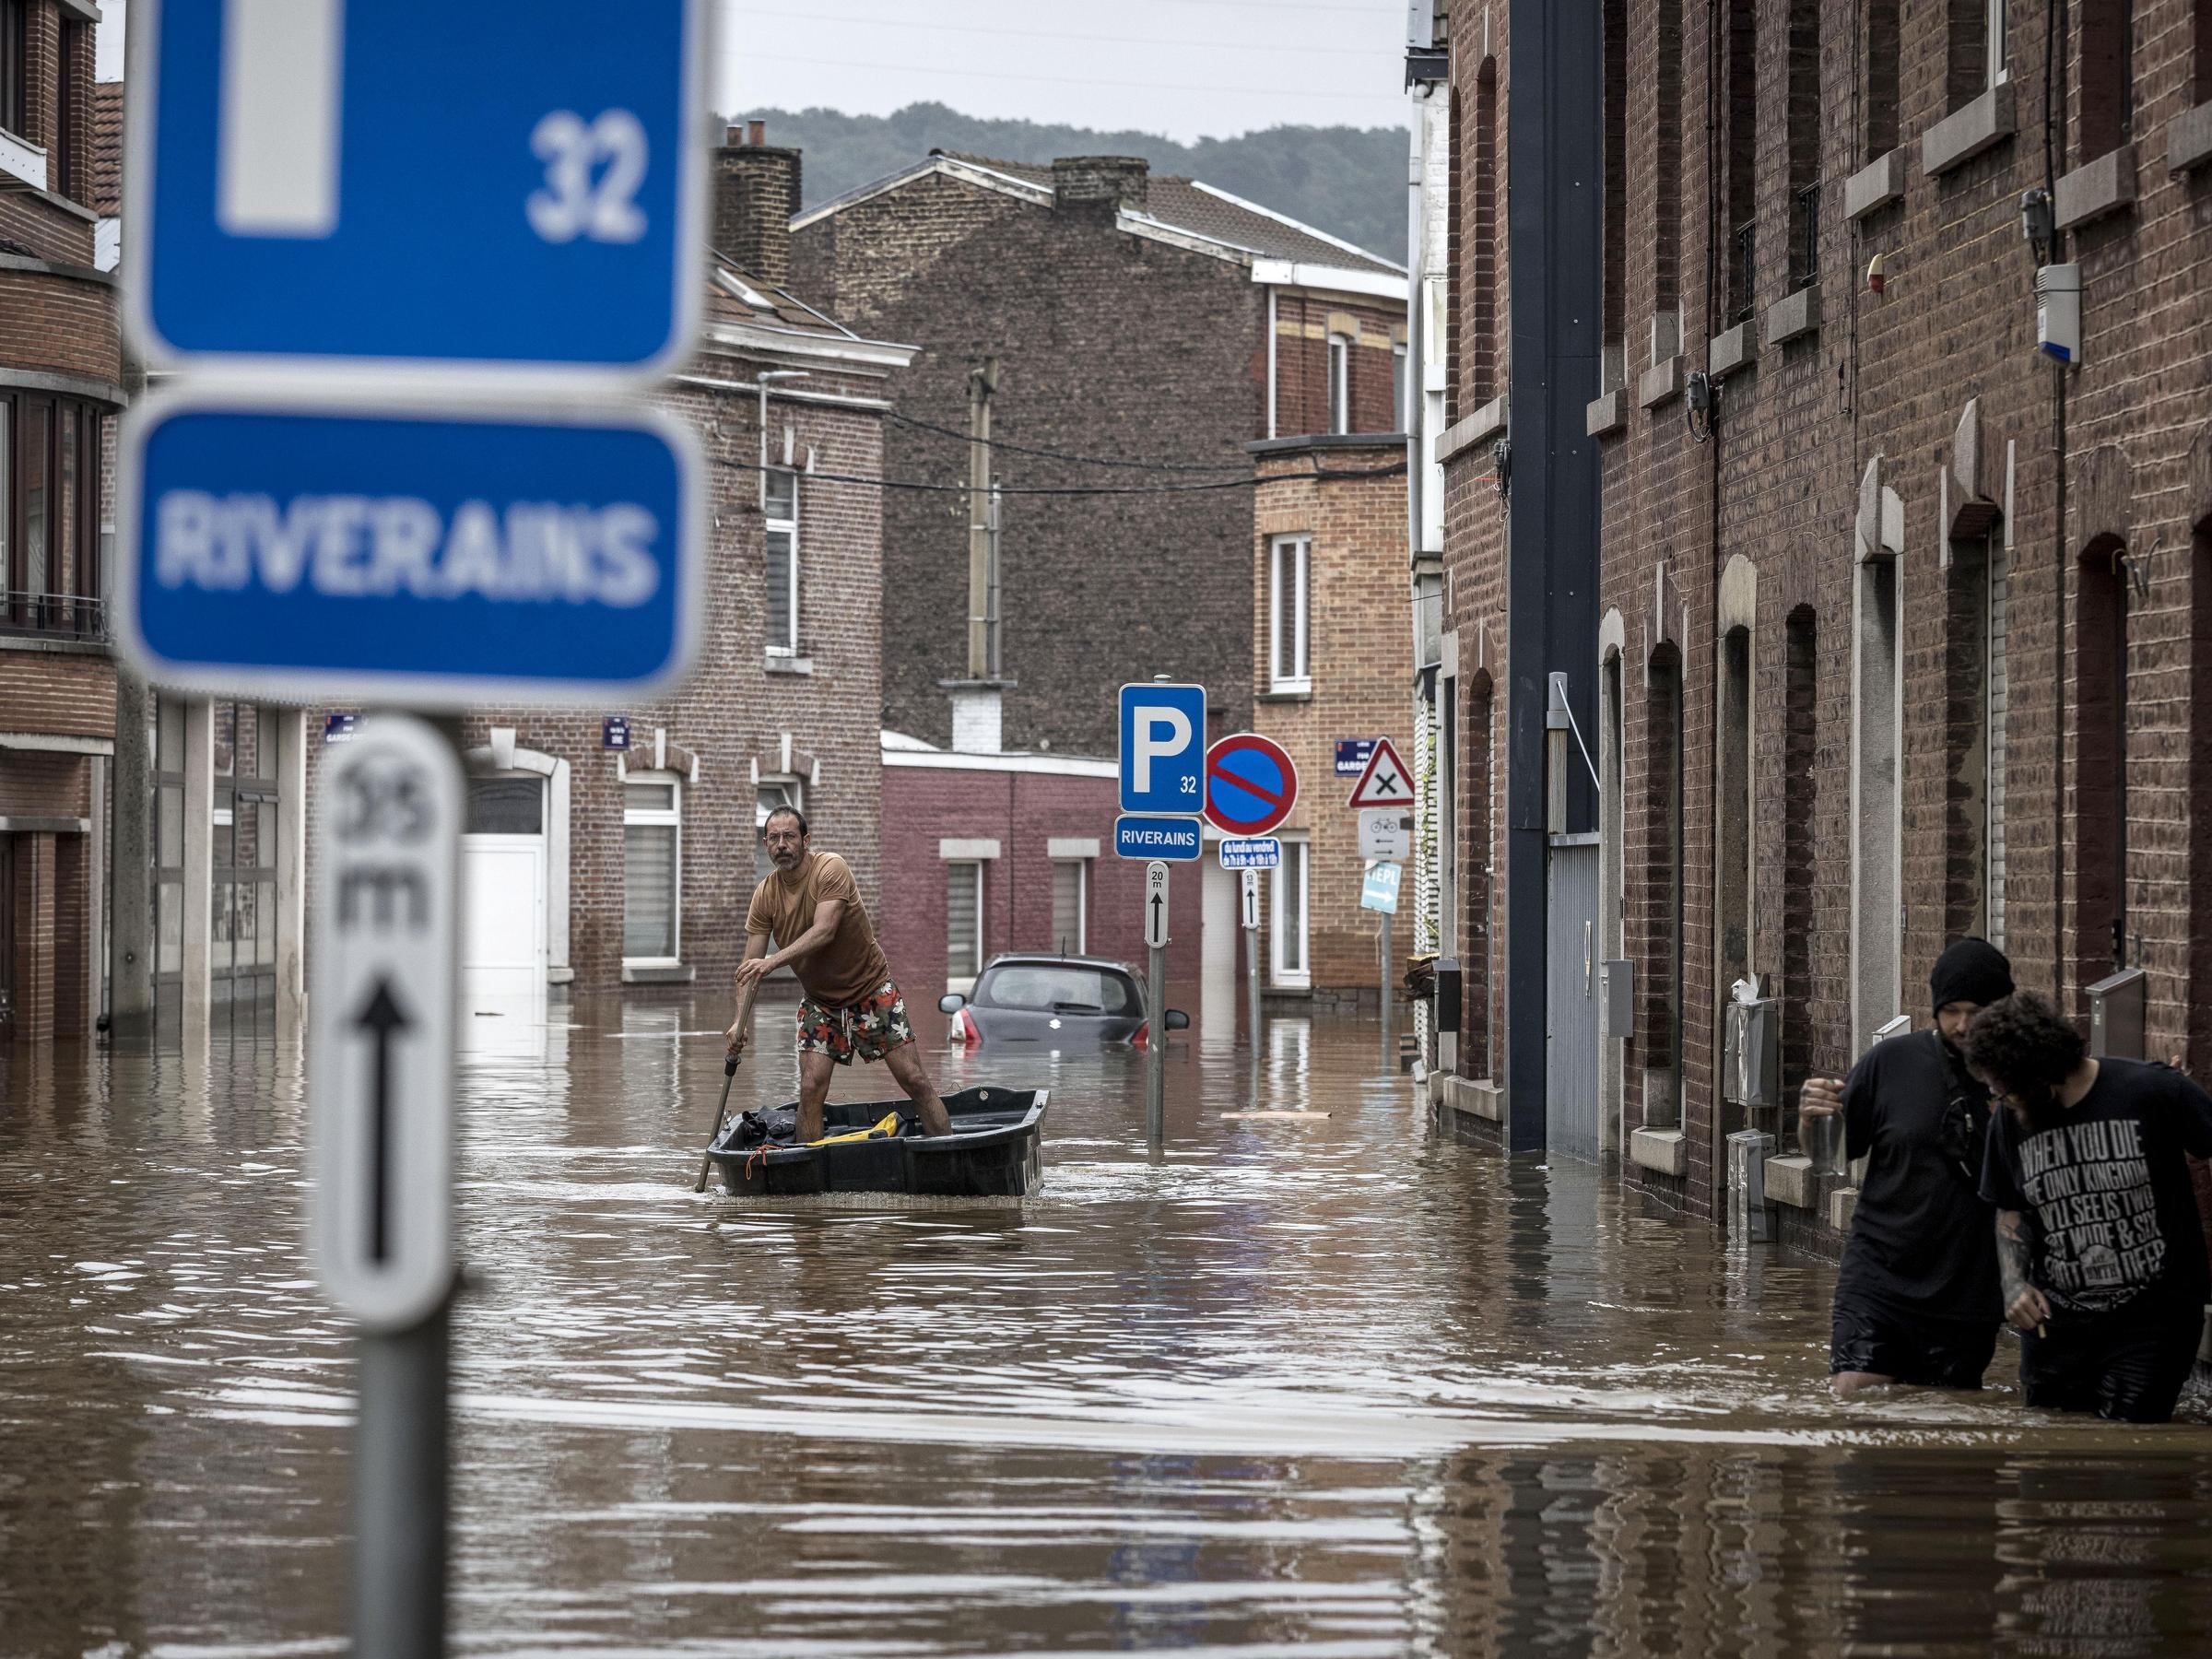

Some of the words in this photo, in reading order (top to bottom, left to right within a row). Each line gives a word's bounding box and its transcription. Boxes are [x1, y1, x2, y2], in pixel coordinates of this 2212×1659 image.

[527, 107, 649, 243] 32
[155, 488, 660, 608] RIVERAINS
[1134, 706, 1192, 793] P
[1180, 776, 1196, 794] 32
[1122, 830, 1194, 846] RIVERAINS
[1151, 871, 1163, 880] 20
[2018, 1126, 2068, 1181] WHEN
[2066, 1121, 2109, 1162] YOU
[2108, 1119, 2146, 1159] DIE
[2042, 1165, 2081, 1201] ONLY
[2080, 1159, 2150, 1193] KINGDOM
[2071, 1194, 2103, 1225] SEE
[2100, 1192, 2121, 1221] IS
[2118, 1183, 2156, 1217] TWO
[2115, 1218, 2136, 1250] &
[2133, 1208, 2163, 1244] SIX
